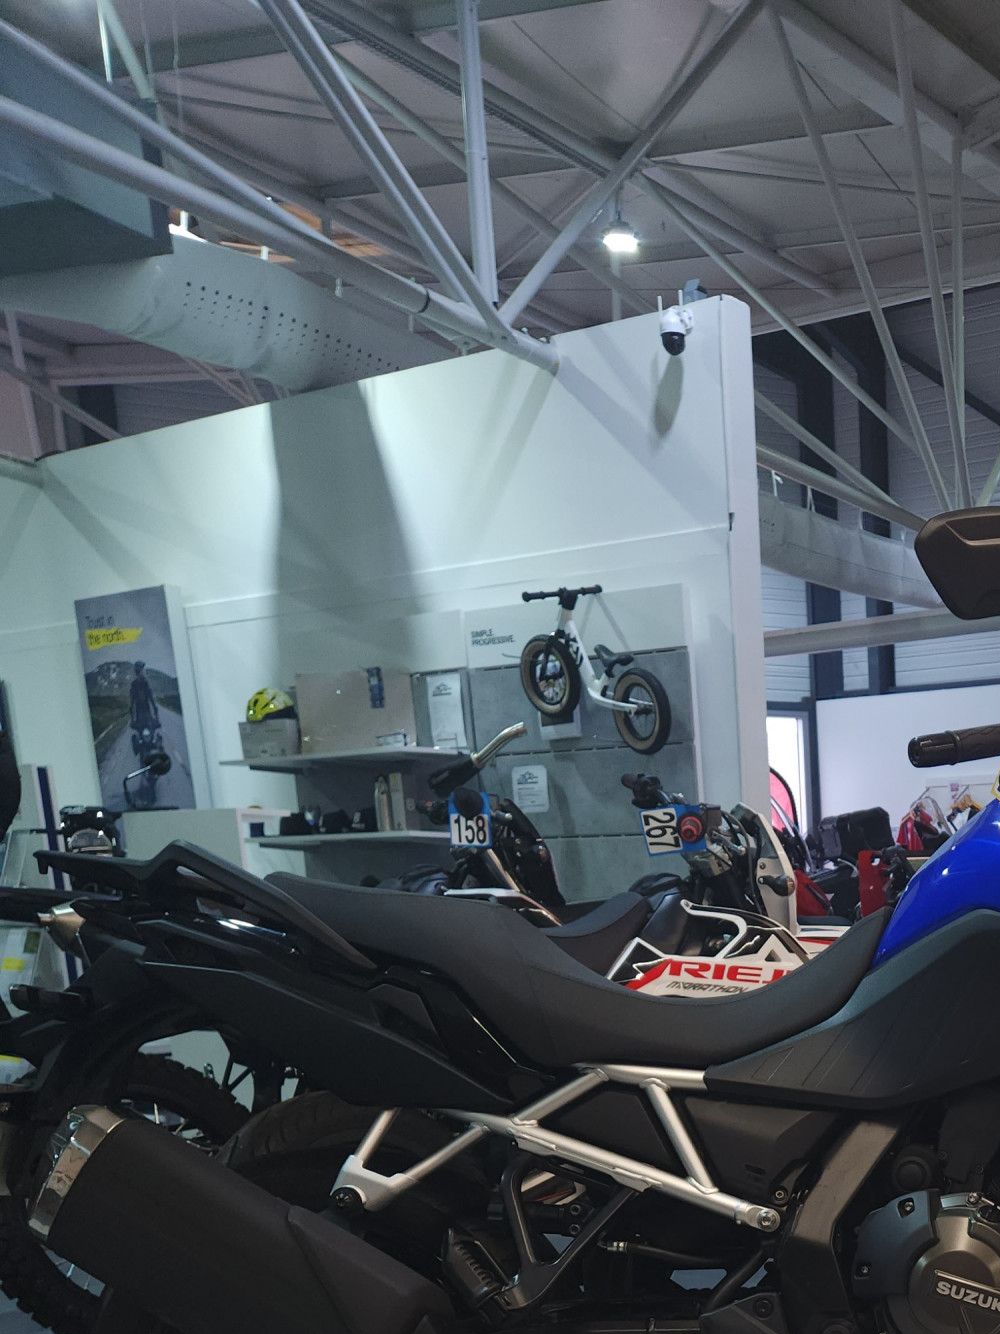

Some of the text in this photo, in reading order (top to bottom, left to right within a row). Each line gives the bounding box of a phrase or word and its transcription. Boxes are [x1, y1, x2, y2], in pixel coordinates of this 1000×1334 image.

[454, 814, 487, 844] 158
[642, 811, 681, 848] 267
[668, 959, 794, 984] RIEJ
[666, 981, 749, 993] MARATHON
